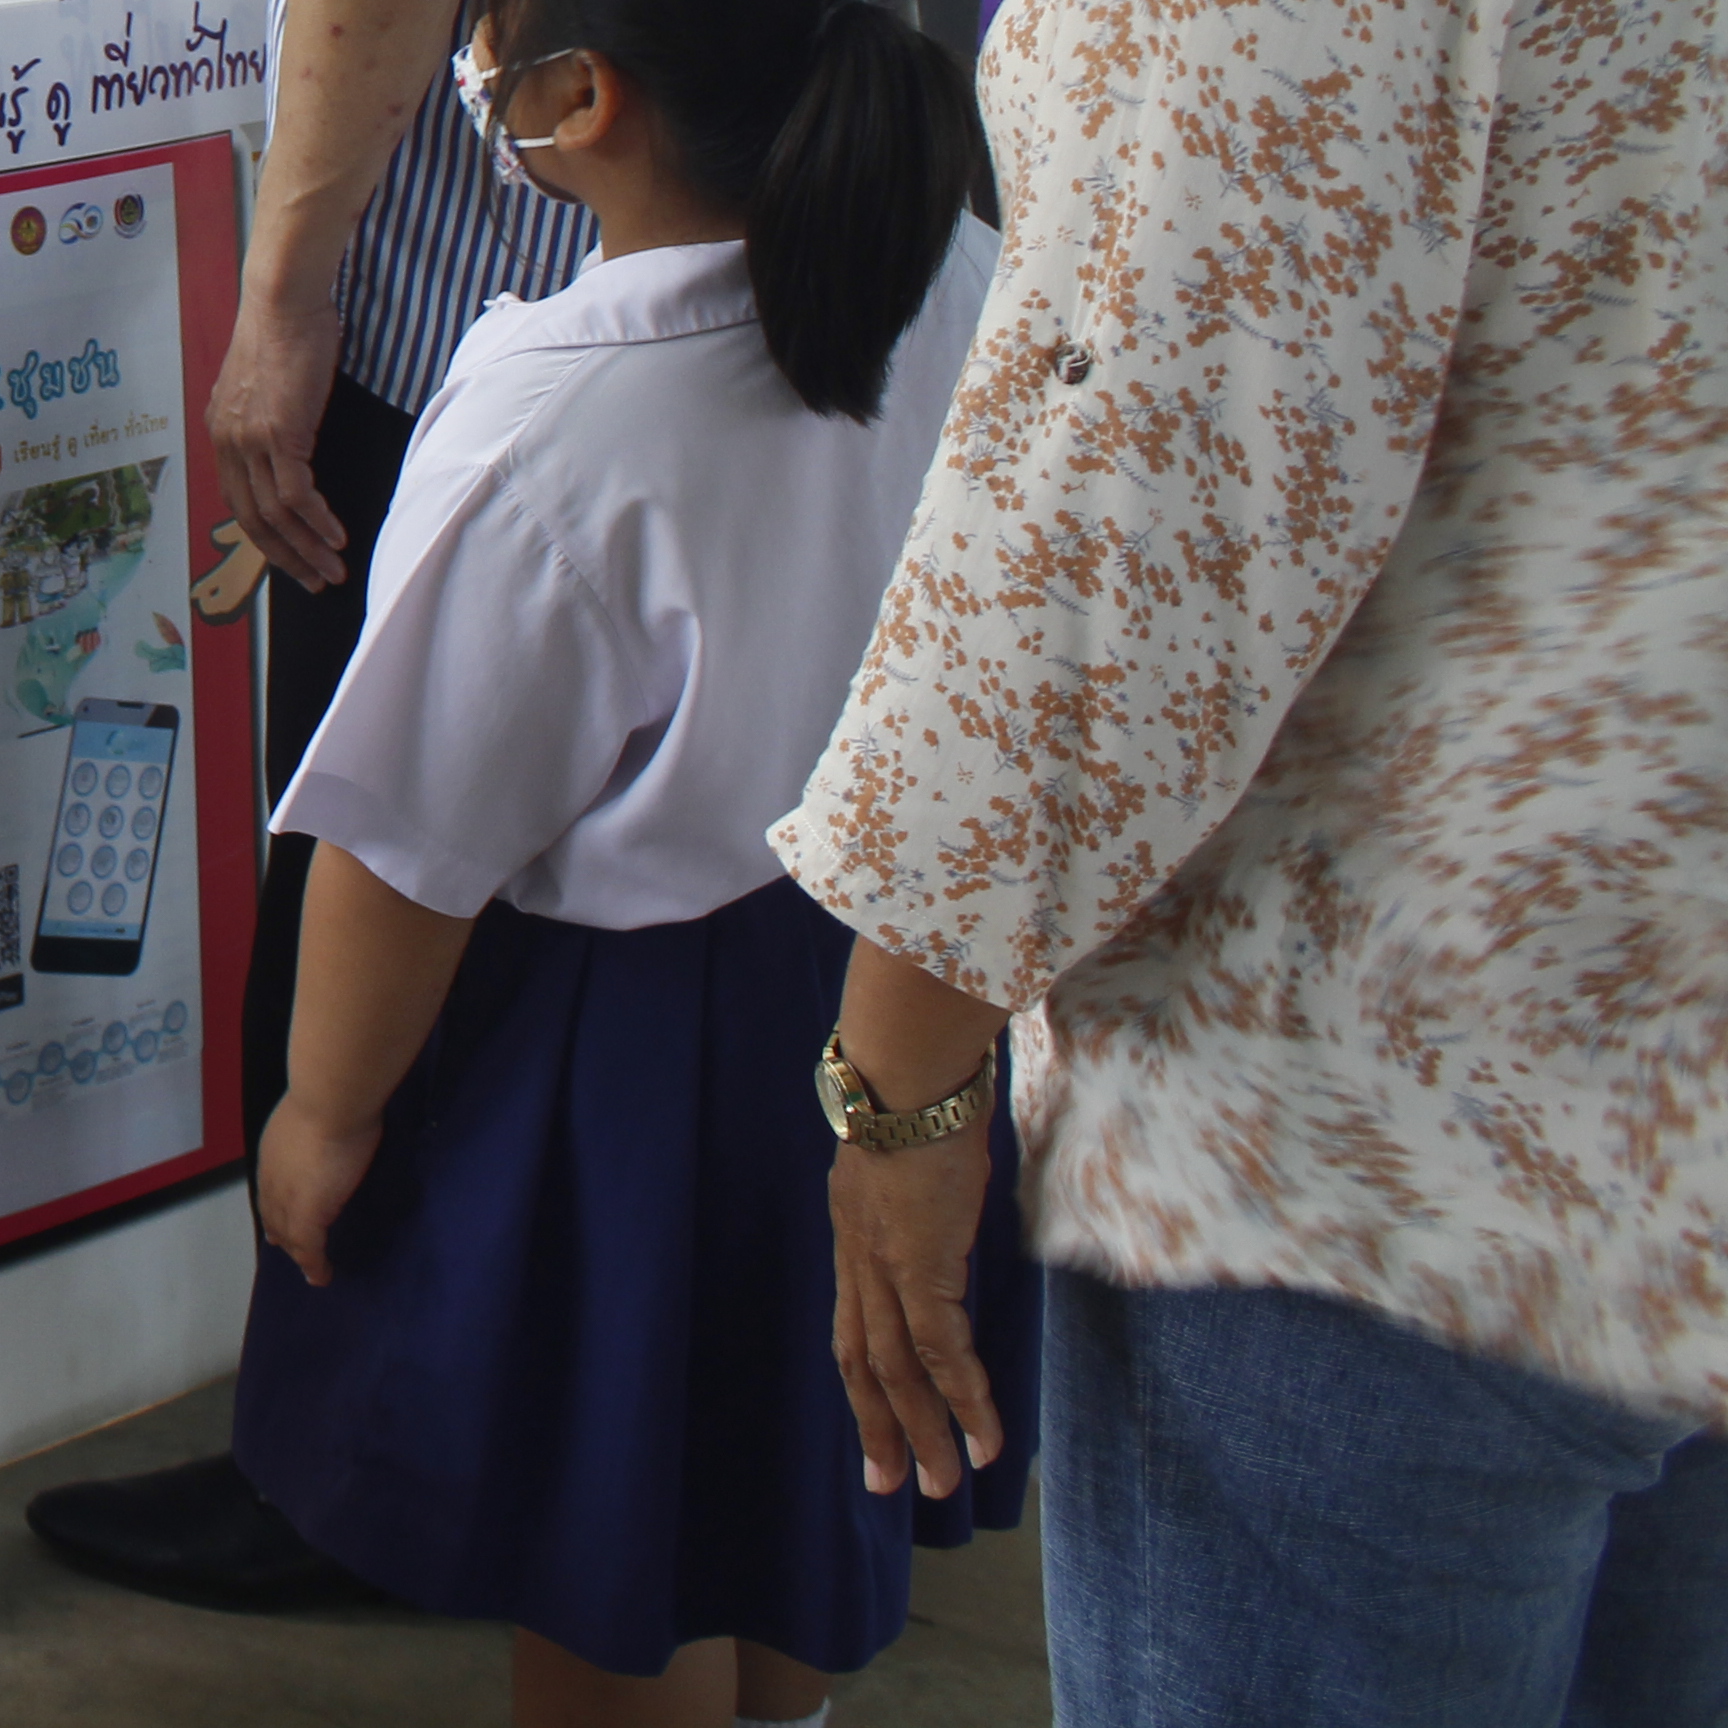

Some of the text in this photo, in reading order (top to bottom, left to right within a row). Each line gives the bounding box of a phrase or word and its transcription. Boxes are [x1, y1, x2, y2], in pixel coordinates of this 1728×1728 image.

[46, 80, 73, 146] ดู
[14, 434, 61, 463] เรียนรู้
